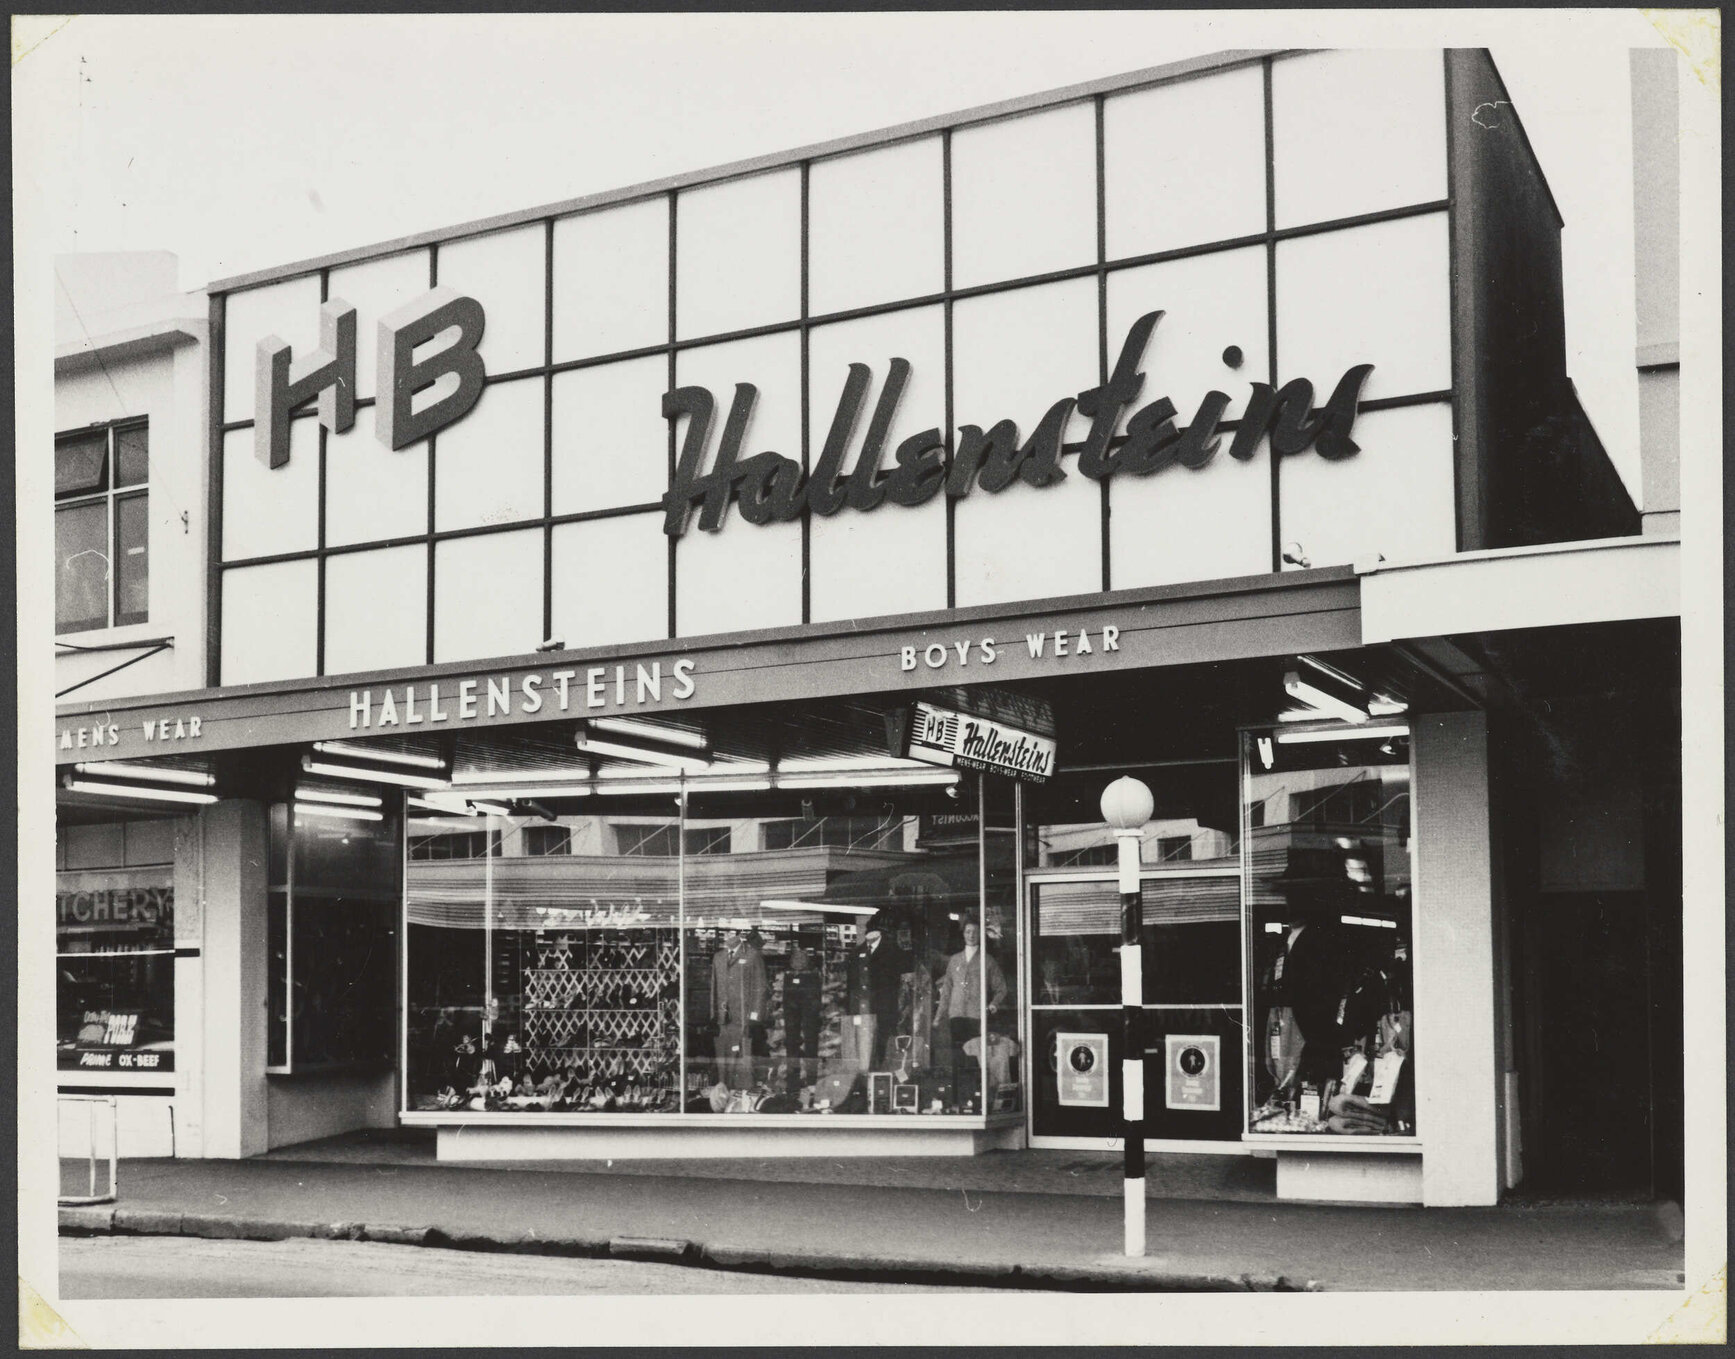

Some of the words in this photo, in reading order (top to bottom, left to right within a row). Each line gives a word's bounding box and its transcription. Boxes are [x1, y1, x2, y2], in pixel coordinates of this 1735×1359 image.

[255, 286, 486, 470] HB
[662, 310, 1376, 536] Hallensteins
[901, 638, 997, 672] BOYS
[1026, 626, 1120, 659] WEAR
[349, 659, 697, 730] HALLENSTEINS
[60, 725, 120, 750] MENS
[143, 716, 204, 742] WEAR
[926, 715, 945, 742] HB
[963, 722, 1051, 774] Hallensteins
[80, 1052, 112, 1067] PRIME
[118, 1054, 160, 1067] OX-BEEF
